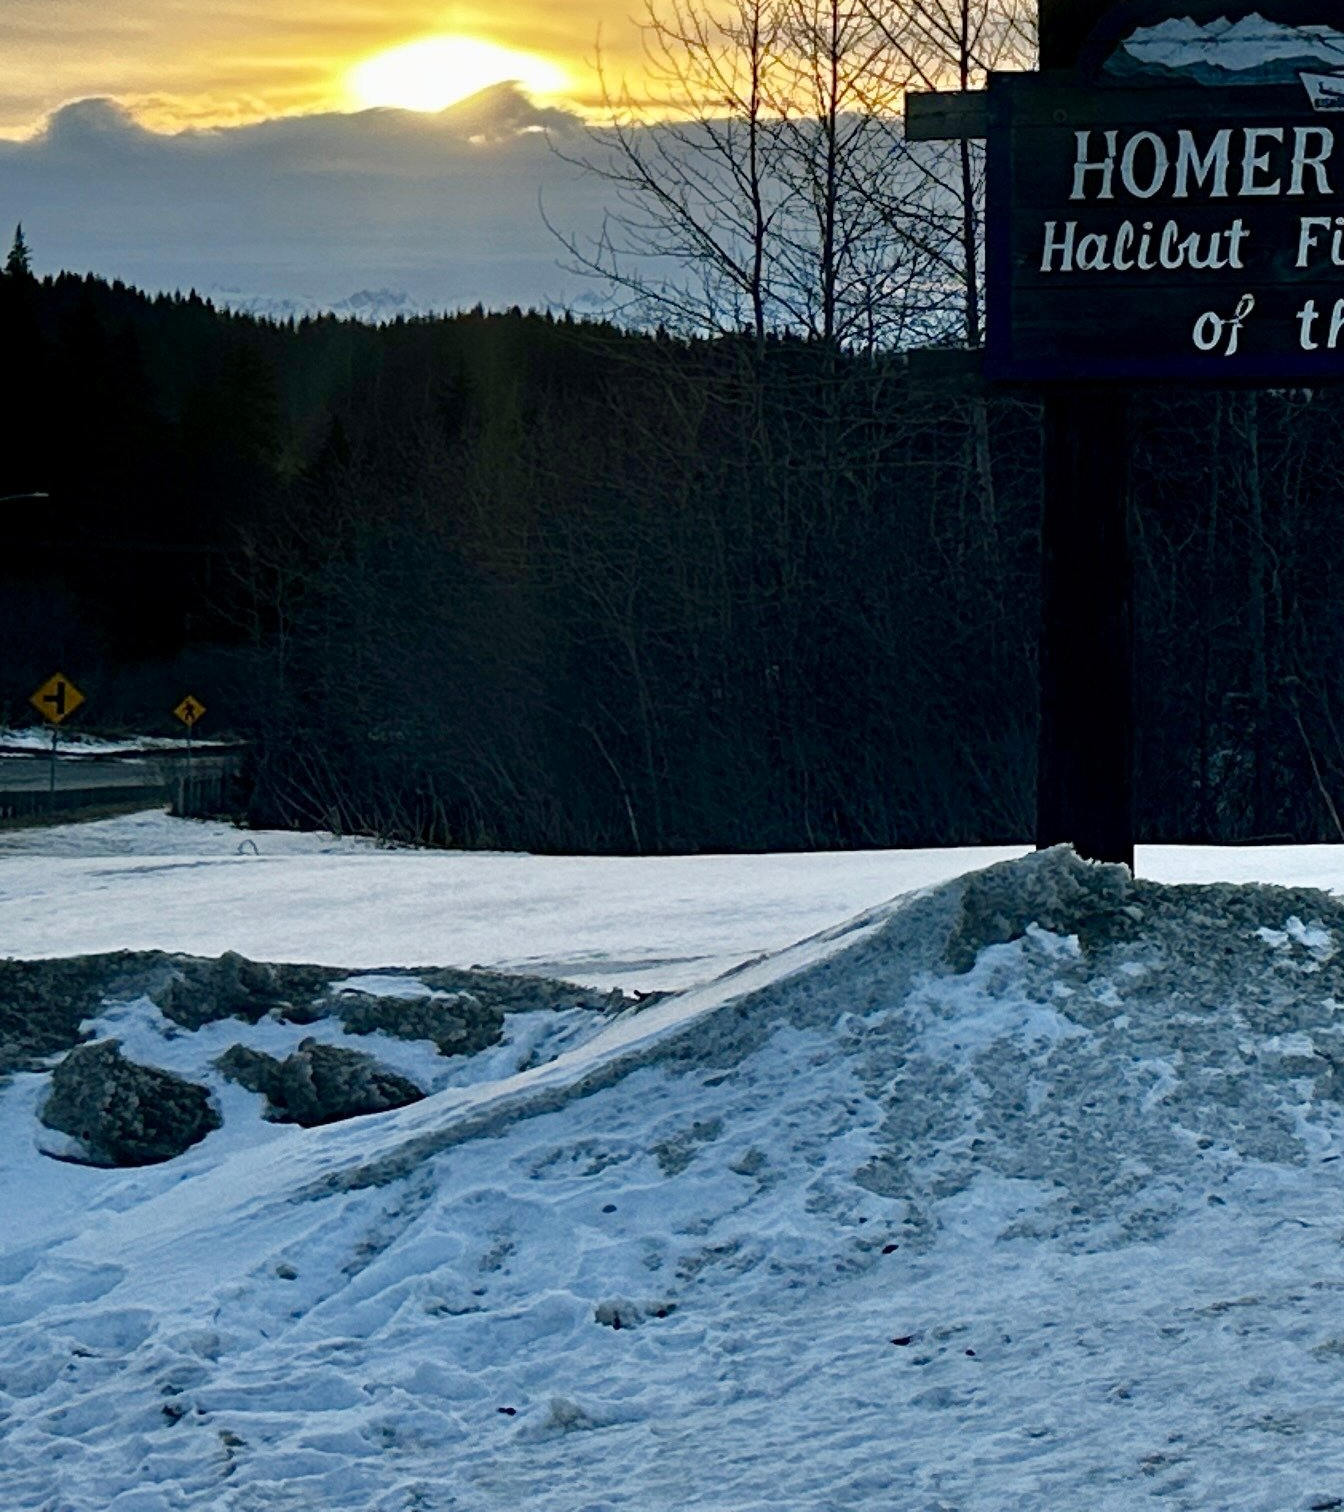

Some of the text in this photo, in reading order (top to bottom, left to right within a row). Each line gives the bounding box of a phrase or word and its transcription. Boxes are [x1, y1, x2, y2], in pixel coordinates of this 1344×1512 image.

[1069, 125, 1335, 200] HOMER
[1039, 217, 1252, 273] Halibut
[1191, 292, 1256, 358] of
